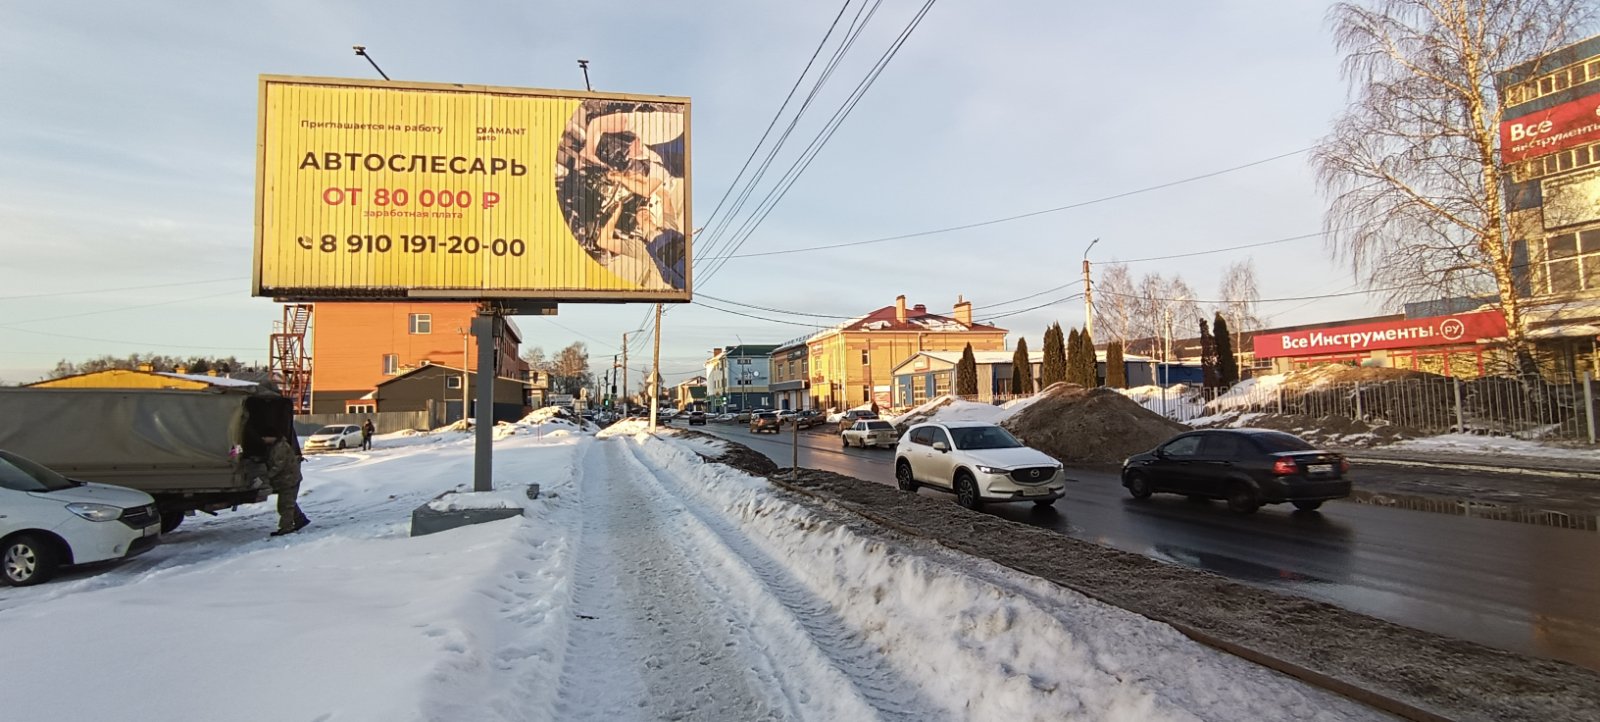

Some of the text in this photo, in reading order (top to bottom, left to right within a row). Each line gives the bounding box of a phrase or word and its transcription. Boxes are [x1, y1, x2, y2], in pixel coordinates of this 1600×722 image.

[301, 119, 444, 134] Приглашается на работу
[476, 126, 527, 135] DIAMANT
[1510, 120, 1553, 142] Все
[299, 151, 528, 177] АВТОСЛЕСАРЬ
[322, 187, 363, 206] ОТ
[373, 188, 409, 207] 80
[418, 189, 472, 208] 000
[363, 208, 463, 220] заработная плата
[319, 234, 525, 257] 8 910 191-20-00
